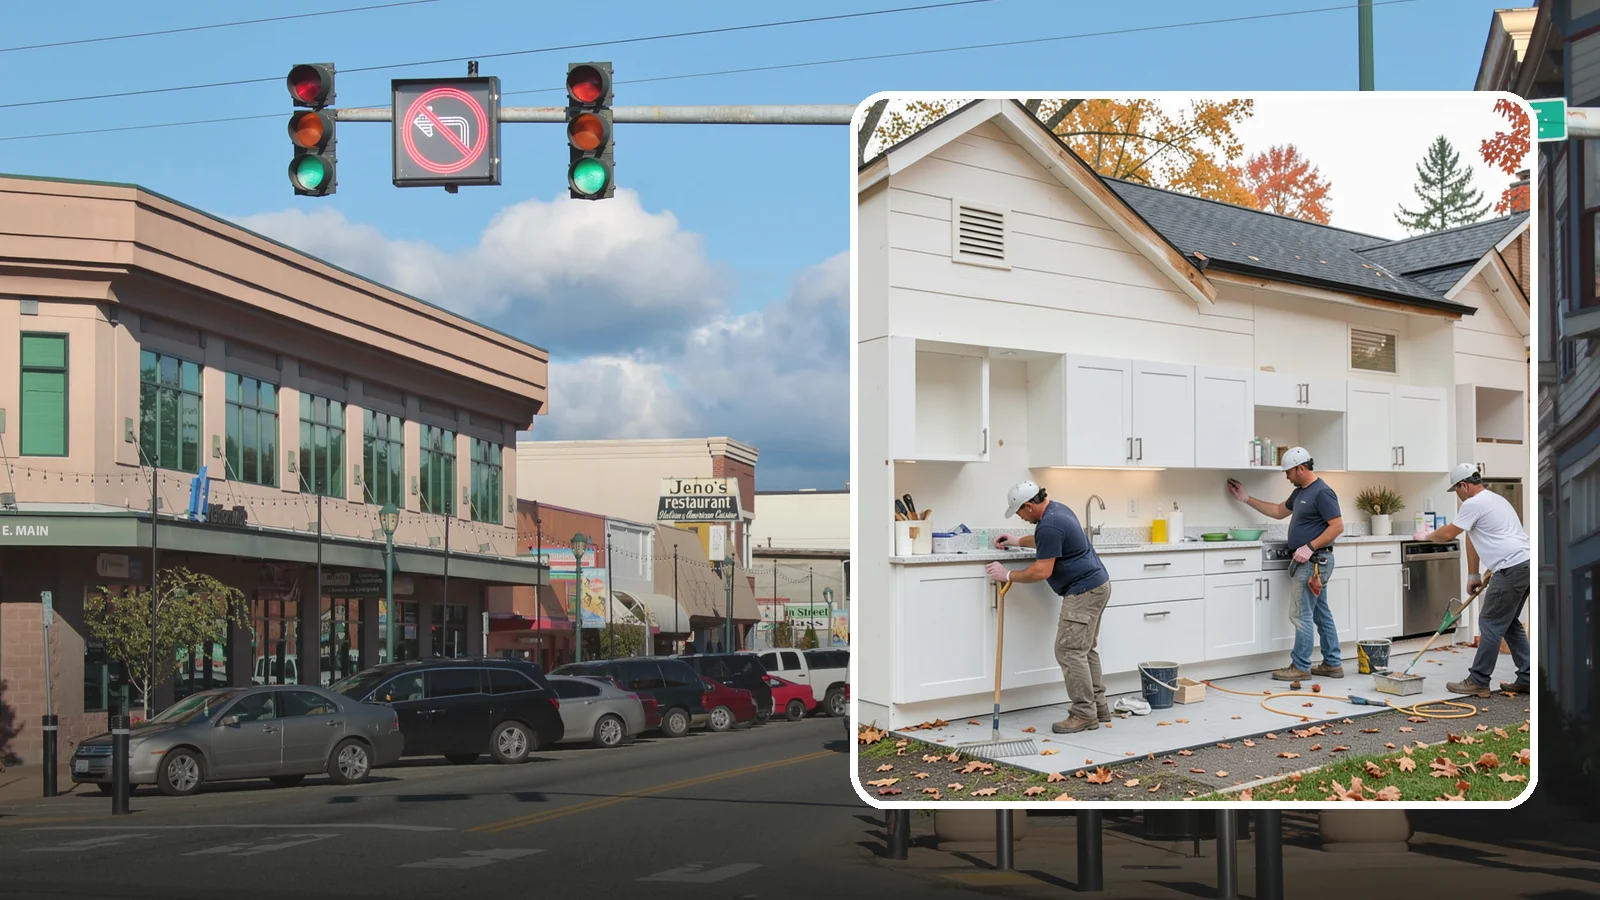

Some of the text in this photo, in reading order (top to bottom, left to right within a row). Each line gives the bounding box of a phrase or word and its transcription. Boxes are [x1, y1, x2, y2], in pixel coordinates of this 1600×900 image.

[670, 480, 727, 494] Jeno's
[665, 496, 731, 509] restaurant
[659, 509, 681, 519] Italian
[686, 510, 714, 519] American
[715, 510, 737, 519] Cuisine
[2, 525, 49, 536] E. MAIN
[797, 607, 828, 617] Street
[791, 619, 823, 627] lass
